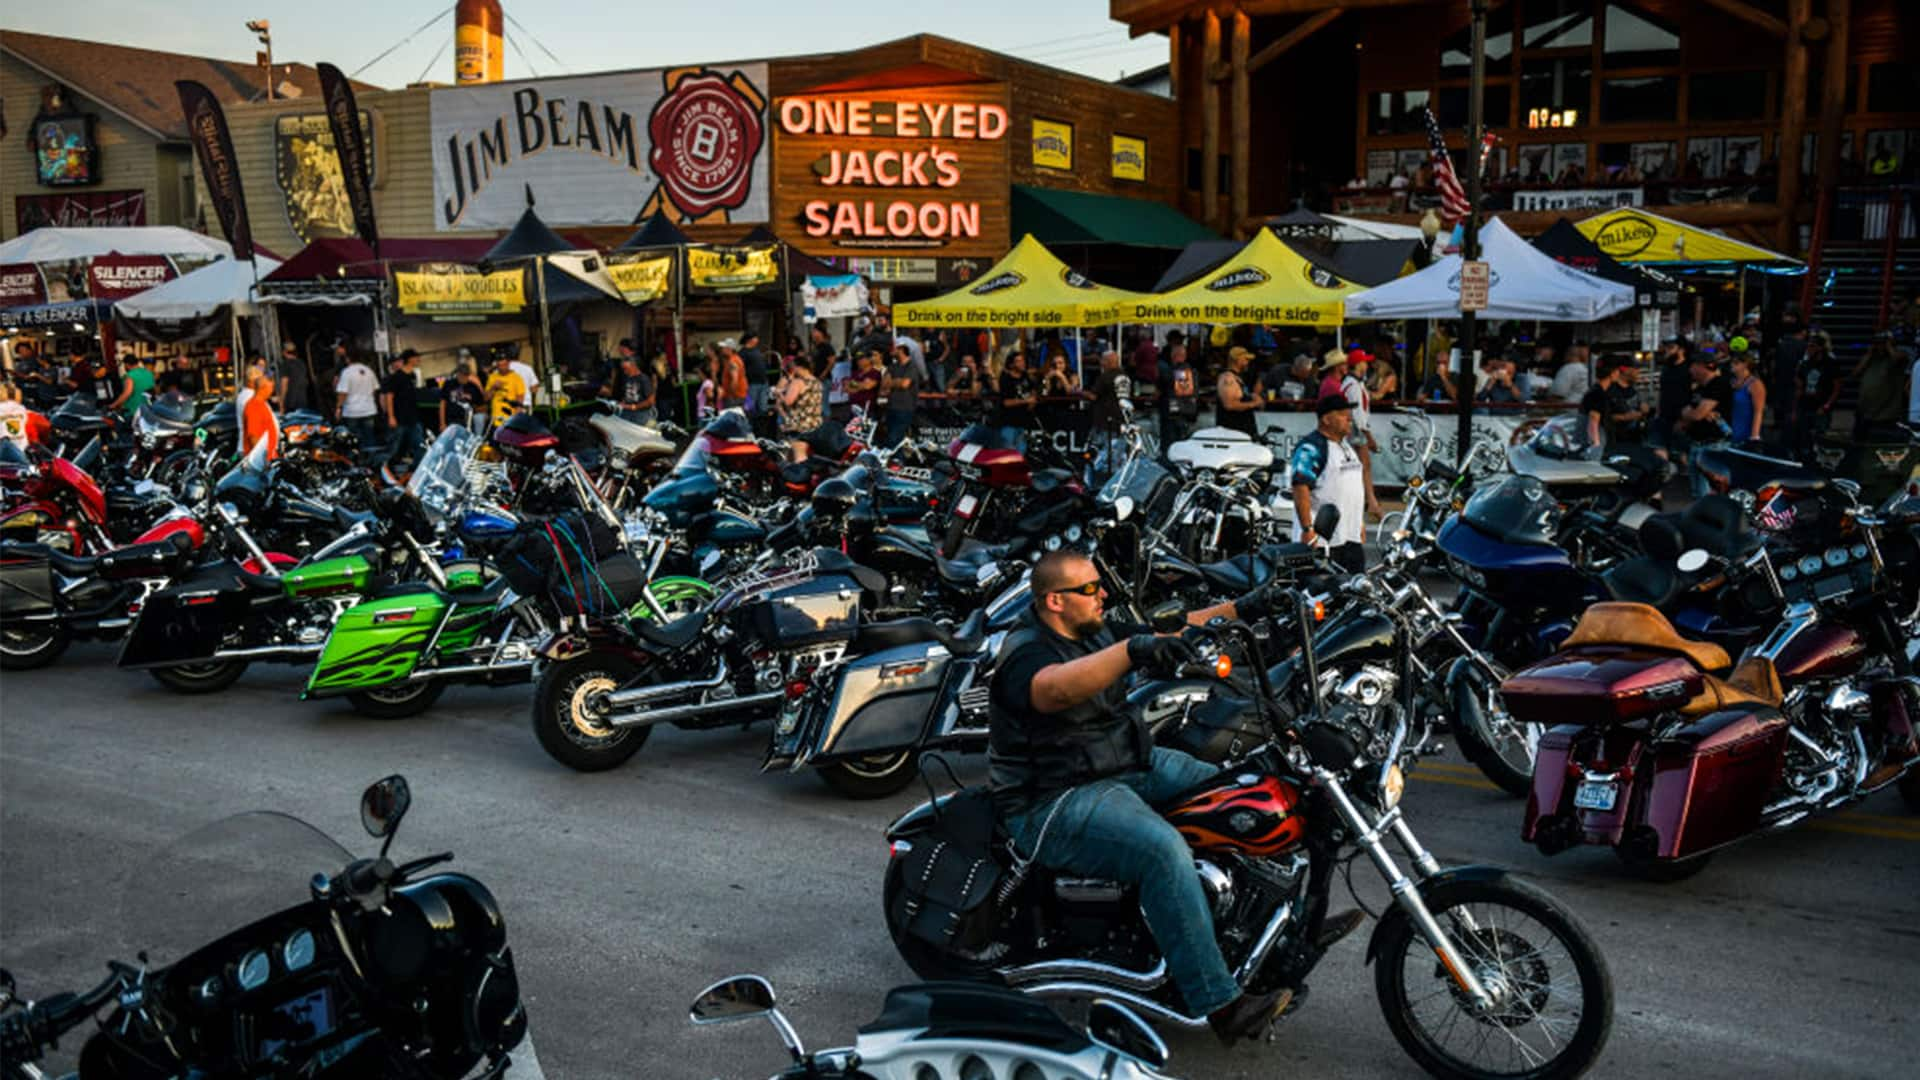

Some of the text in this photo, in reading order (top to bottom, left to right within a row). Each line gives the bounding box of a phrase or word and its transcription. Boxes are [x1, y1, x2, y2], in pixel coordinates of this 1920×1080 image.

[681, 101, 738, 143] JIM BEAM
[780, 98, 1009, 140] ONE-EYED
[445, 117, 511, 225] JIM
[513, 87, 639, 172] BEAM
[691, 122, 719, 161] B
[672, 138, 733, 184] SINCE 1795
[820, 145, 961, 188] JACK'S
[804, 200, 980, 238] SALOON
[0, 272, 37, 286] ENCER
[92, 264, 167, 280] SILENCER
[24, 310, 34, 323] A
[35, 306, 89, 322] SILENCER
[907, 309, 1063, 326] Drink on the bright side
[1135, 304, 1176, 318] Drink
[1180, 307, 1200, 318] on
[1204, 304, 1230, 318] the
[1232, 304, 1281, 322] bright
[1285, 306, 1321, 322] side
